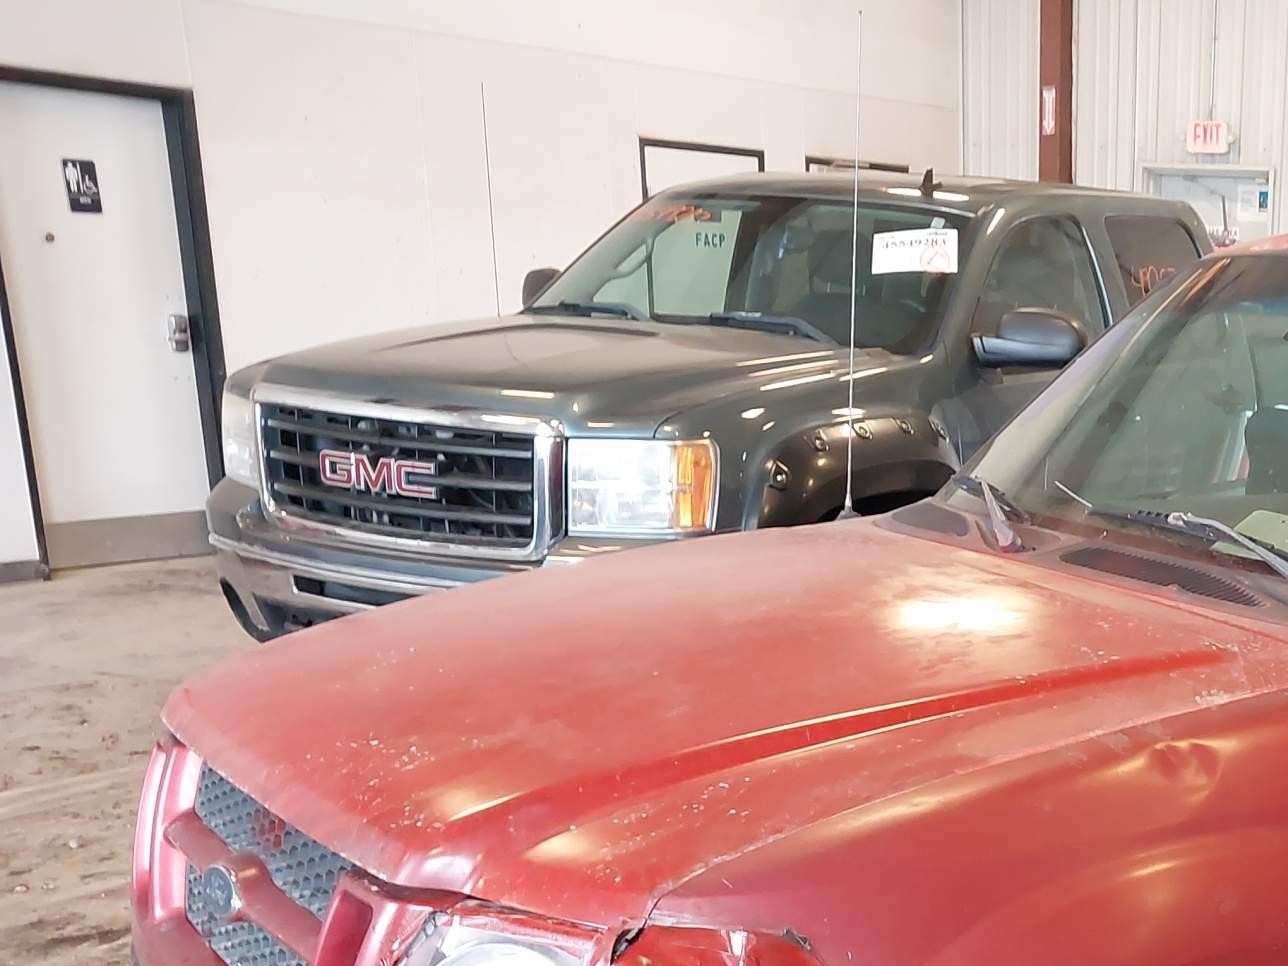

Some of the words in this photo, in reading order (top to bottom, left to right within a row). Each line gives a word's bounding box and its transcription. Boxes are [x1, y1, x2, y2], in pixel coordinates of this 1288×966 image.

[1193, 122, 1222, 145] EXIT
[695, 232, 726, 248] FACP
[320, 449, 437, 499] GMC
